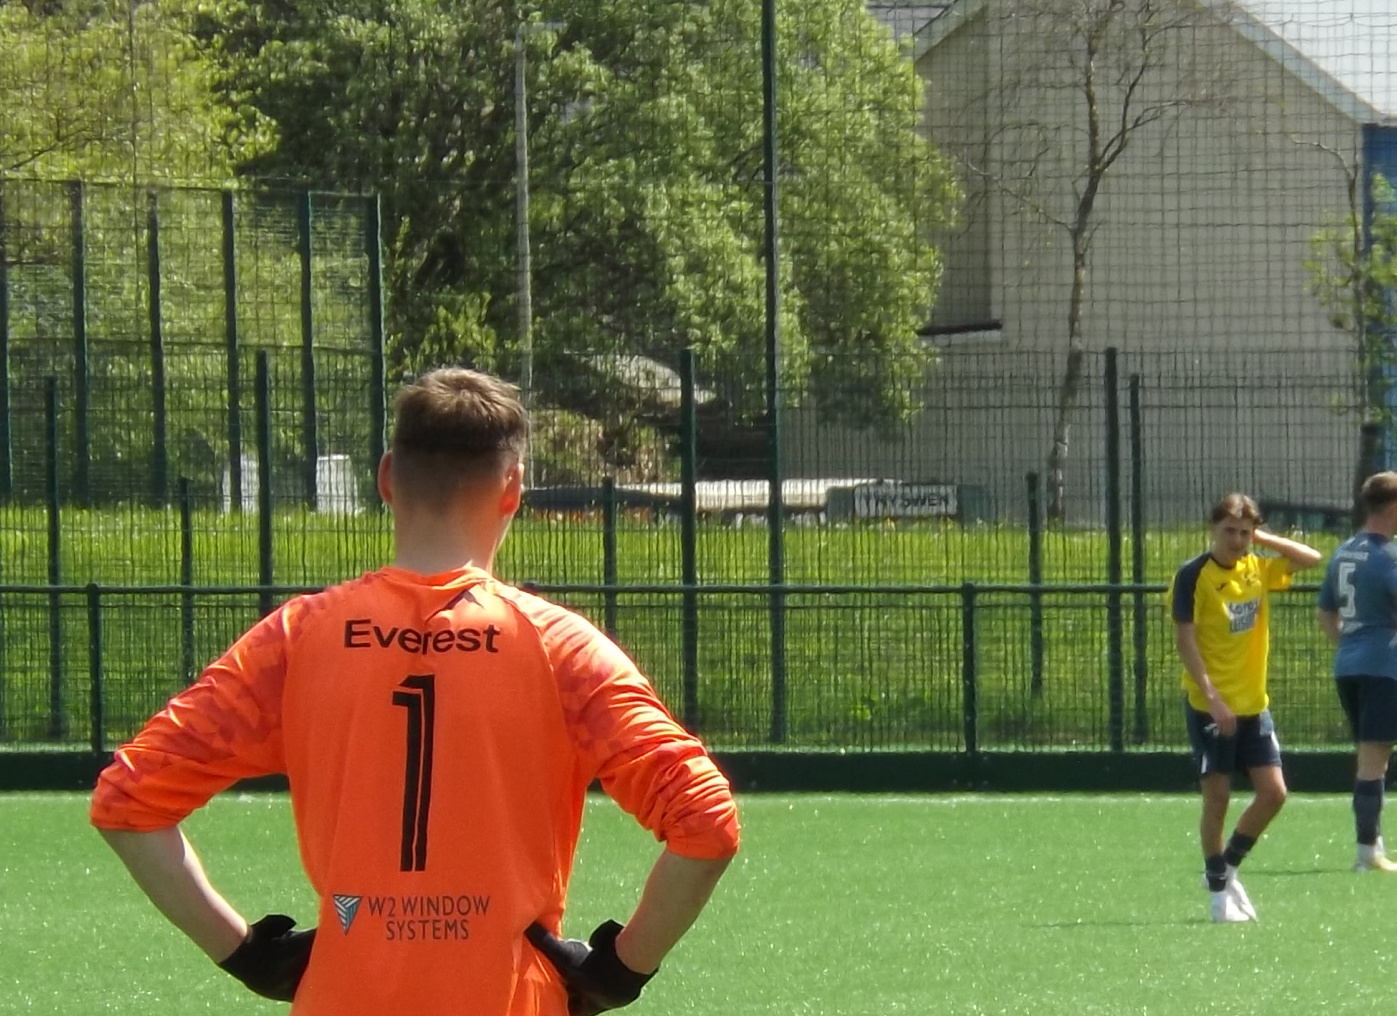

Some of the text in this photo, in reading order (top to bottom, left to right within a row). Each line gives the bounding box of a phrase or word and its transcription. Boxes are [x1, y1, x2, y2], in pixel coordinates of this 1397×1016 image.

[1338, 561, 1356, 617] 5
[344, 619, 500, 655] Everest
[392, 674, 435, 872] 1
[368, 896, 490, 917] W2 WINDOW
[385, 919, 469, 940] SYSTEMS
